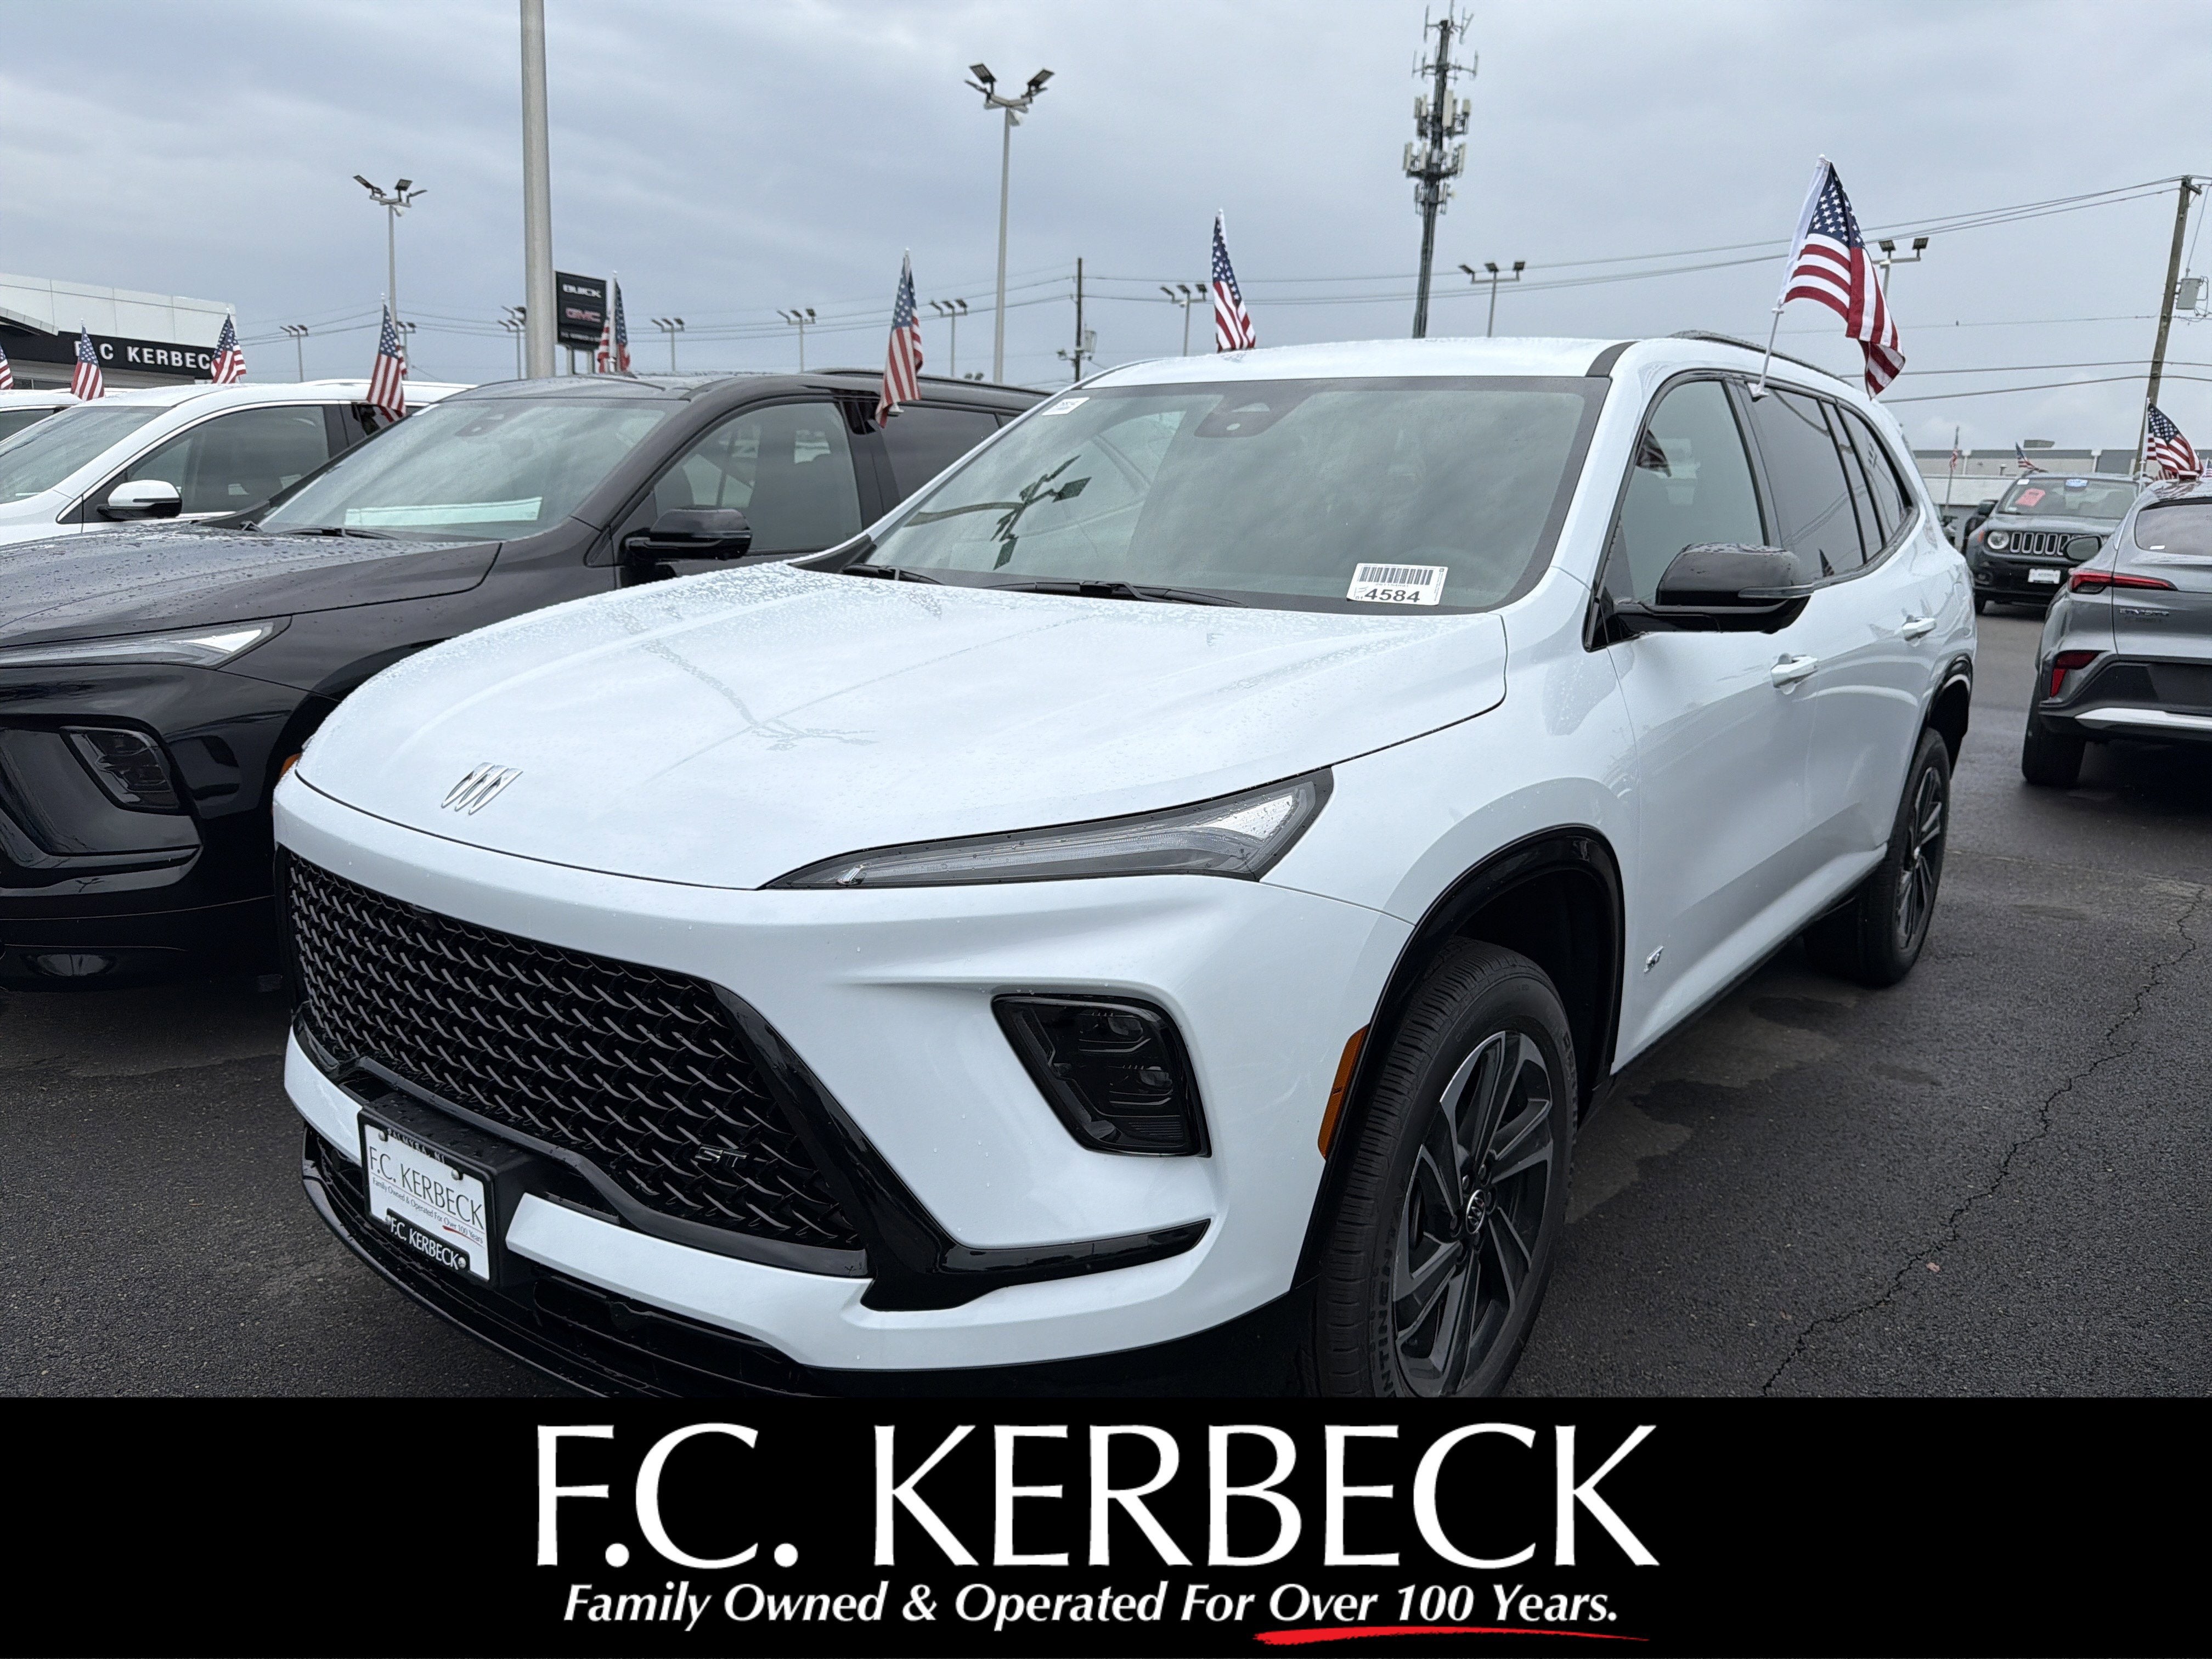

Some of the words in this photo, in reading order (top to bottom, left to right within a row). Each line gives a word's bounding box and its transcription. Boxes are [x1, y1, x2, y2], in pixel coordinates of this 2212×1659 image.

[562, 284, 601, 298] BUICK
[565, 307, 601, 323] GMC
[99, 343, 114, 360] C
[126, 346, 210, 370] KERBEC
[1364, 588, 1420, 602] 4584
[369, 1146, 396, 1183] F.C.
[400, 1163, 484, 1230] KERBECK
[373, 1177, 387, 1193] Family
[388, 1186, 405, 1201] Owned
[410, 1199, 433, 1217] Operated
[443, 1217, 456, 1229] Over
[458, 1224, 468, 1235] 100
[390, 1217, 407, 1241] F.C.
[409, 1228, 459, 1270] KERBECK
